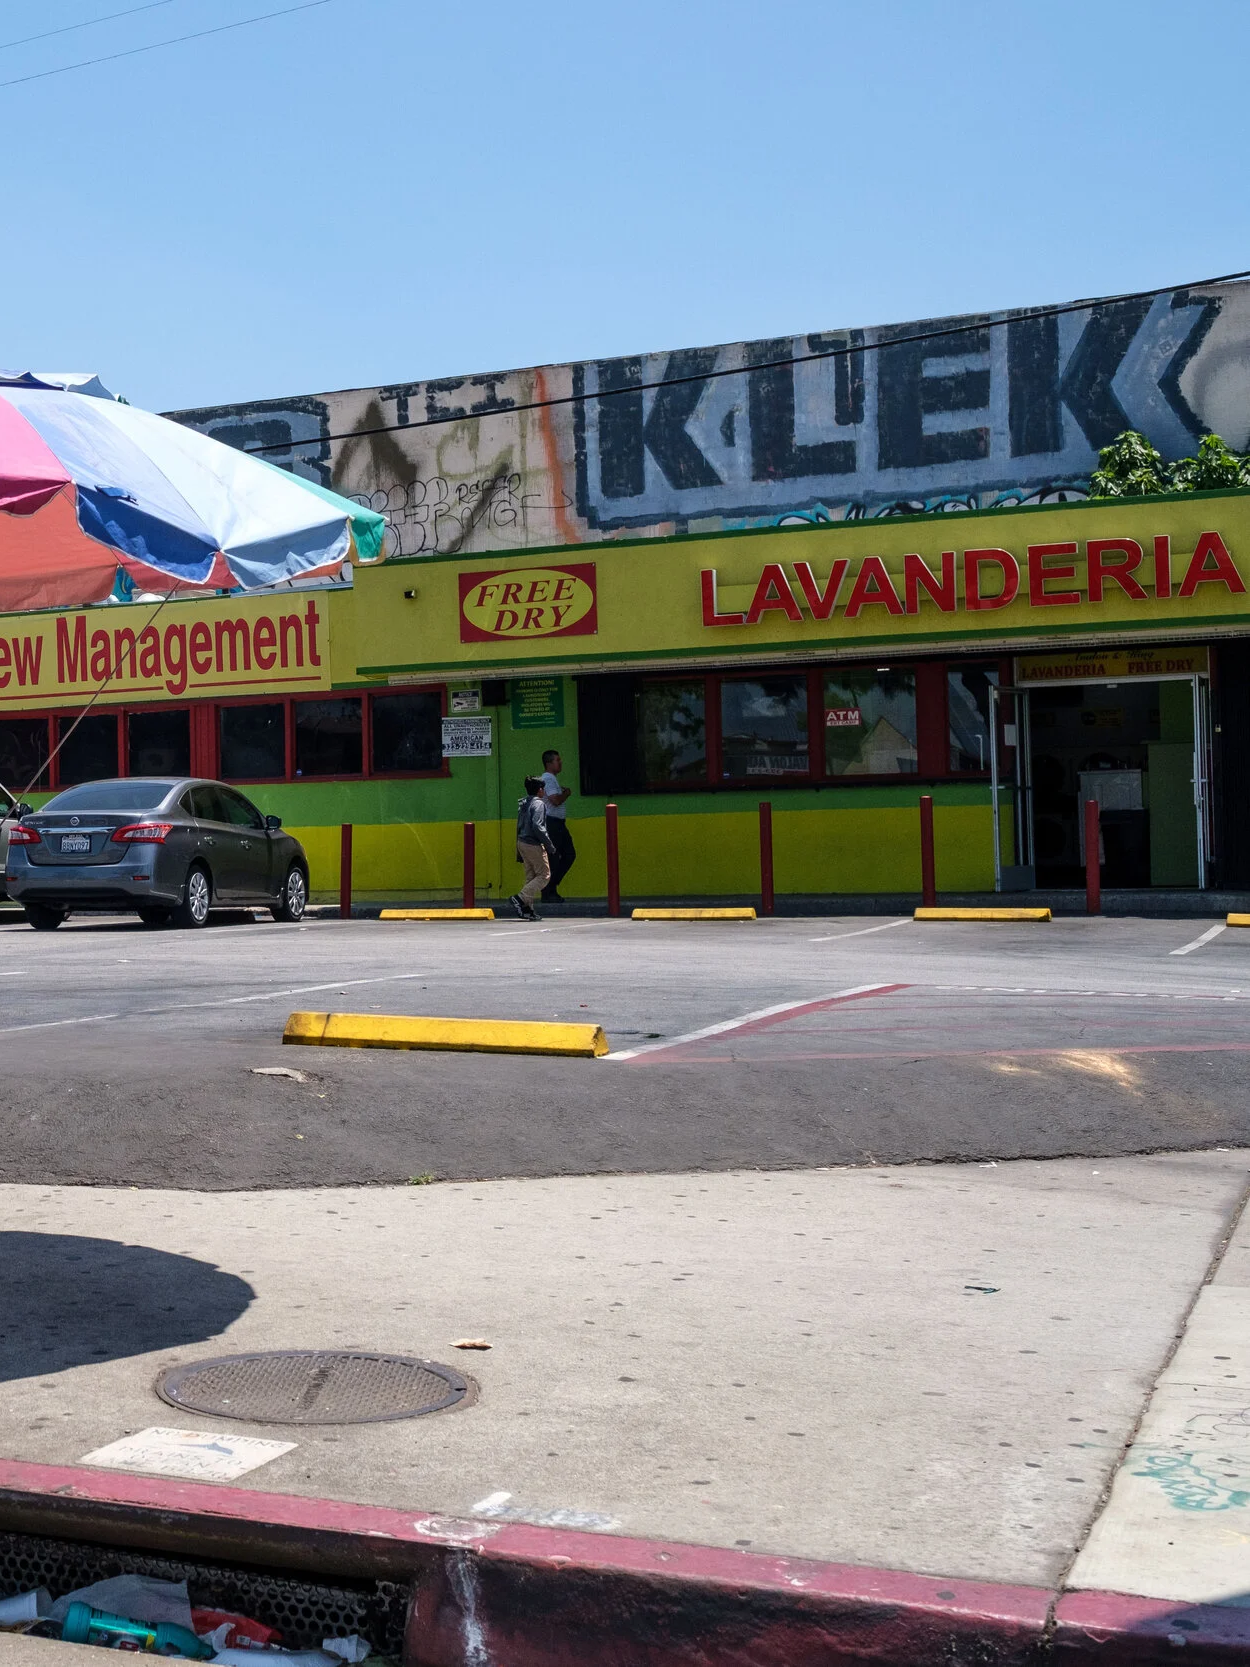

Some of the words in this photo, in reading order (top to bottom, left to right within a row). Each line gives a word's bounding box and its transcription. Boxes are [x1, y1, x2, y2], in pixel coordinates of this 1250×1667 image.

[473, 578, 577, 608] FREE
[699, 530, 1247, 627] LAVANDERIA
[491, 604, 573, 632] DRY
[56, 600, 322, 696] Management
[1022, 663, 1107, 679] LAVANDERIA
[1127, 660, 1163, 674] FREE
[1166, 658, 1195, 673] DRY
[826, 710, 860, 721] ATM
